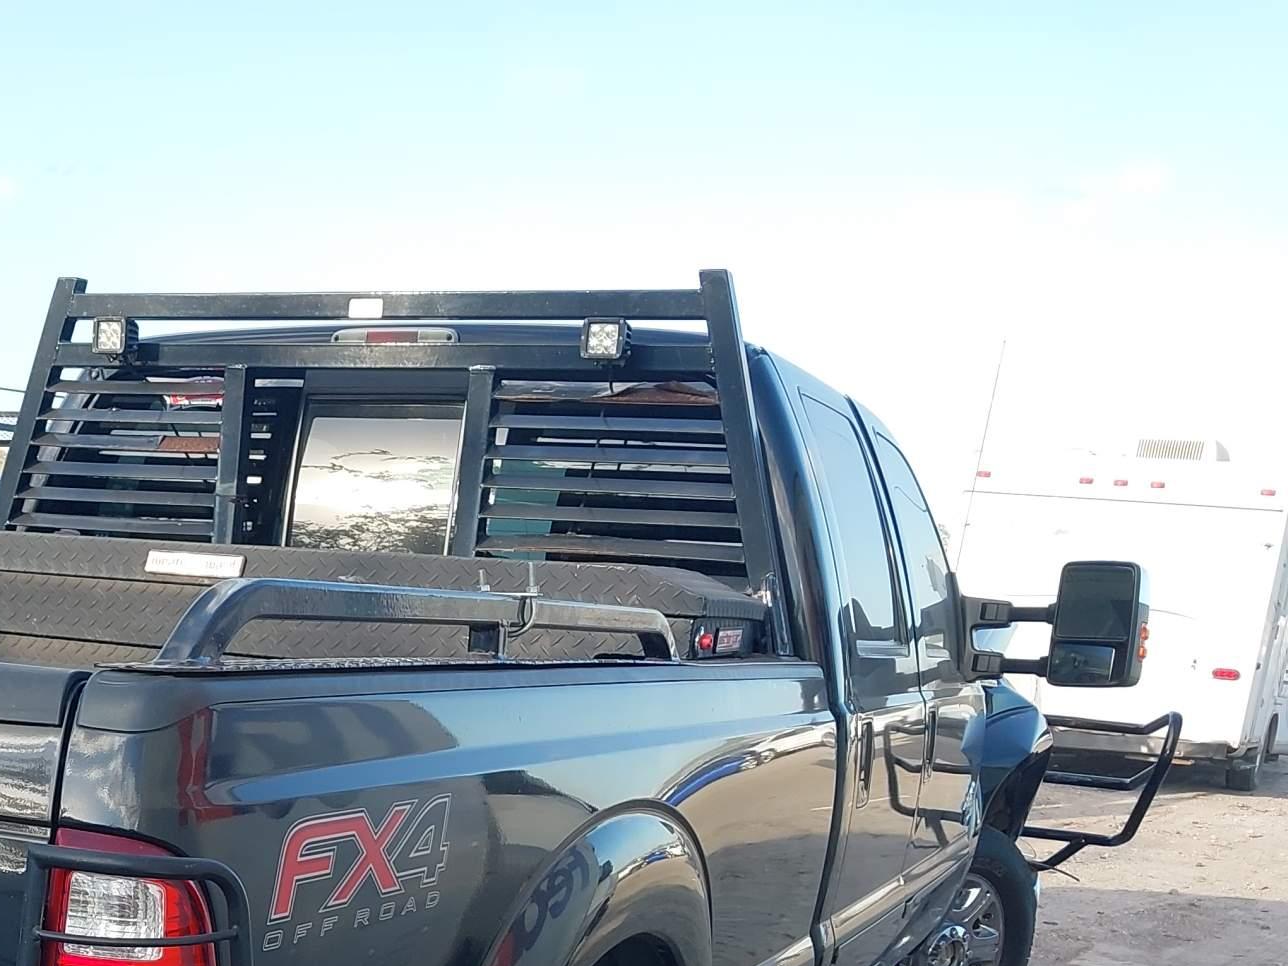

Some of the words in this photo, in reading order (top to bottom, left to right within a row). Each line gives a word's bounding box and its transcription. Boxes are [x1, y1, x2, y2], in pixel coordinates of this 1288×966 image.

[266, 792, 452, 925] FX4
[262, 916, 339, 951] OFF
[353, 890, 441, 928] ROAD
